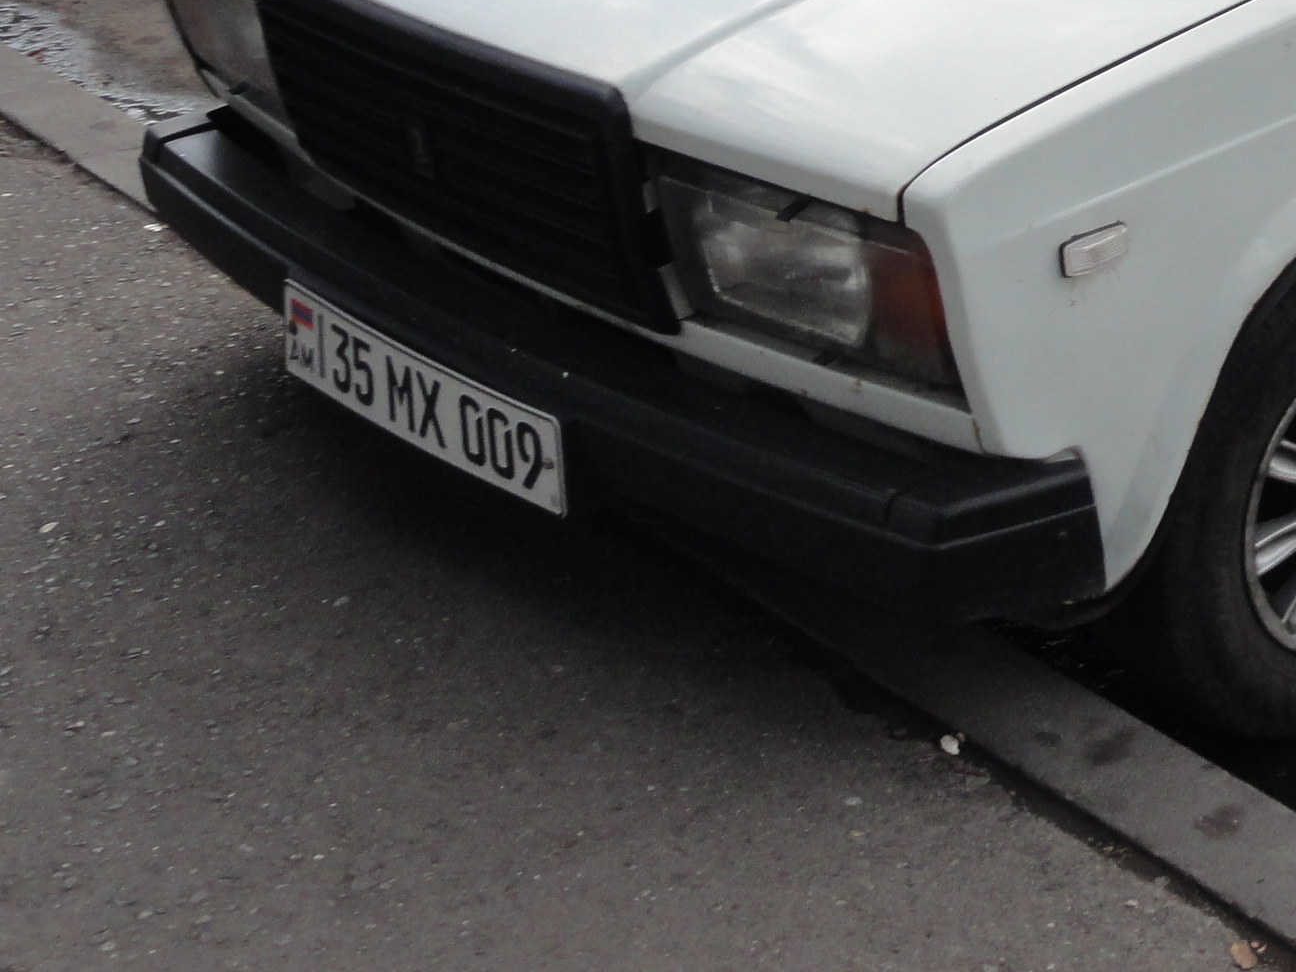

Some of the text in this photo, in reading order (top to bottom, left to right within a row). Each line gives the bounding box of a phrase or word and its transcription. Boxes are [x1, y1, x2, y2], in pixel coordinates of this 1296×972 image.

[330, 322, 543, 490] 35 MX 009
